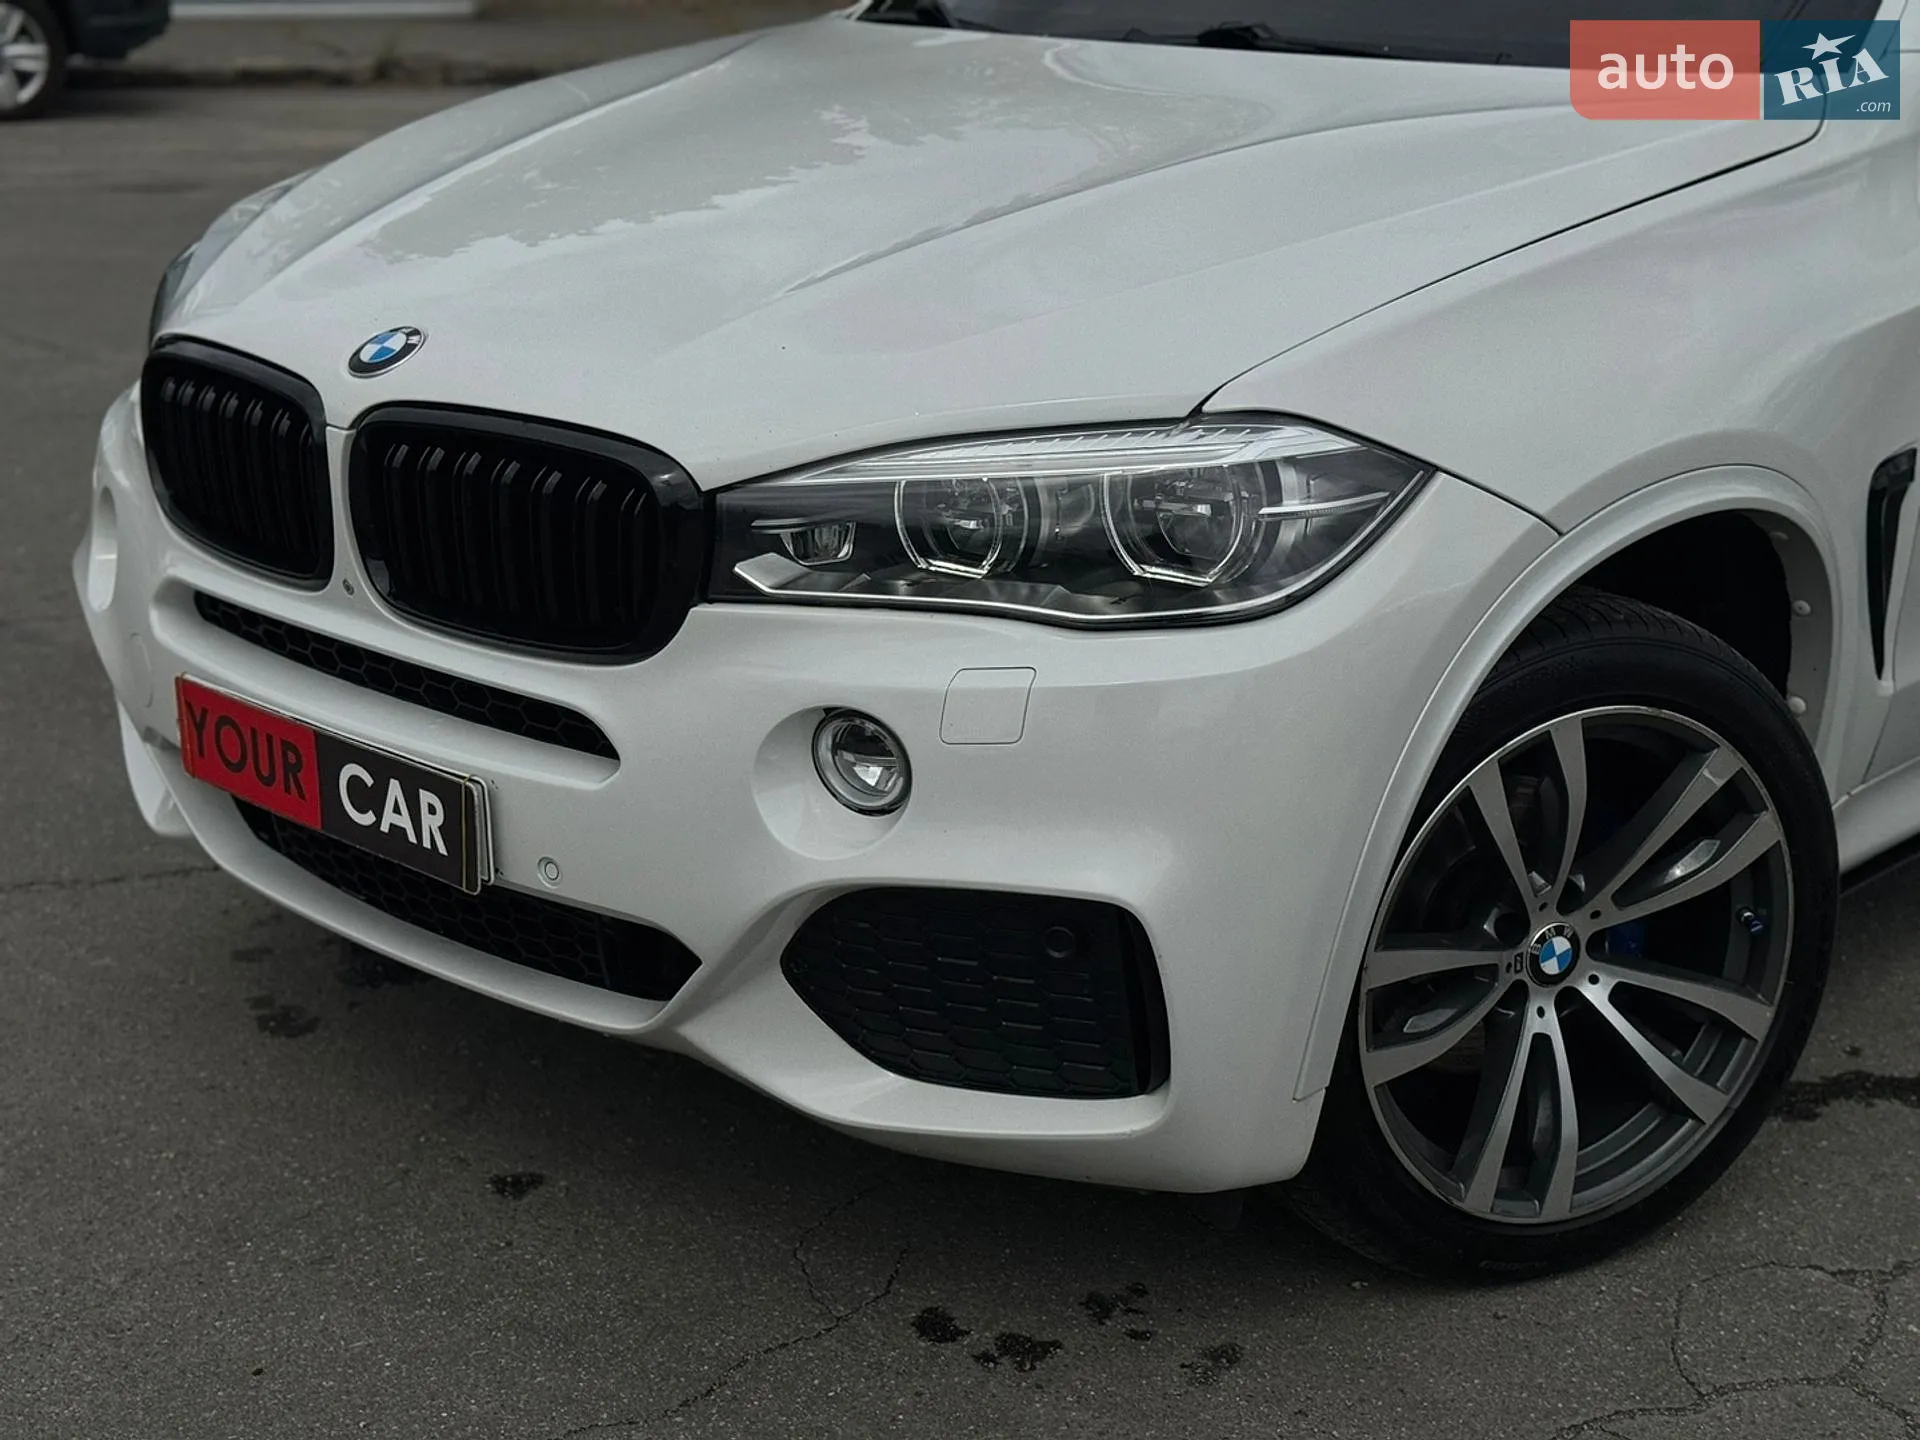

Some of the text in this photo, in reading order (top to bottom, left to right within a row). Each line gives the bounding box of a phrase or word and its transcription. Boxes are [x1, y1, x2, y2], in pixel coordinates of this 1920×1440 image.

[185, 700, 448, 856] YOUR CAR
[1530, 926, 1575, 956] BMW
